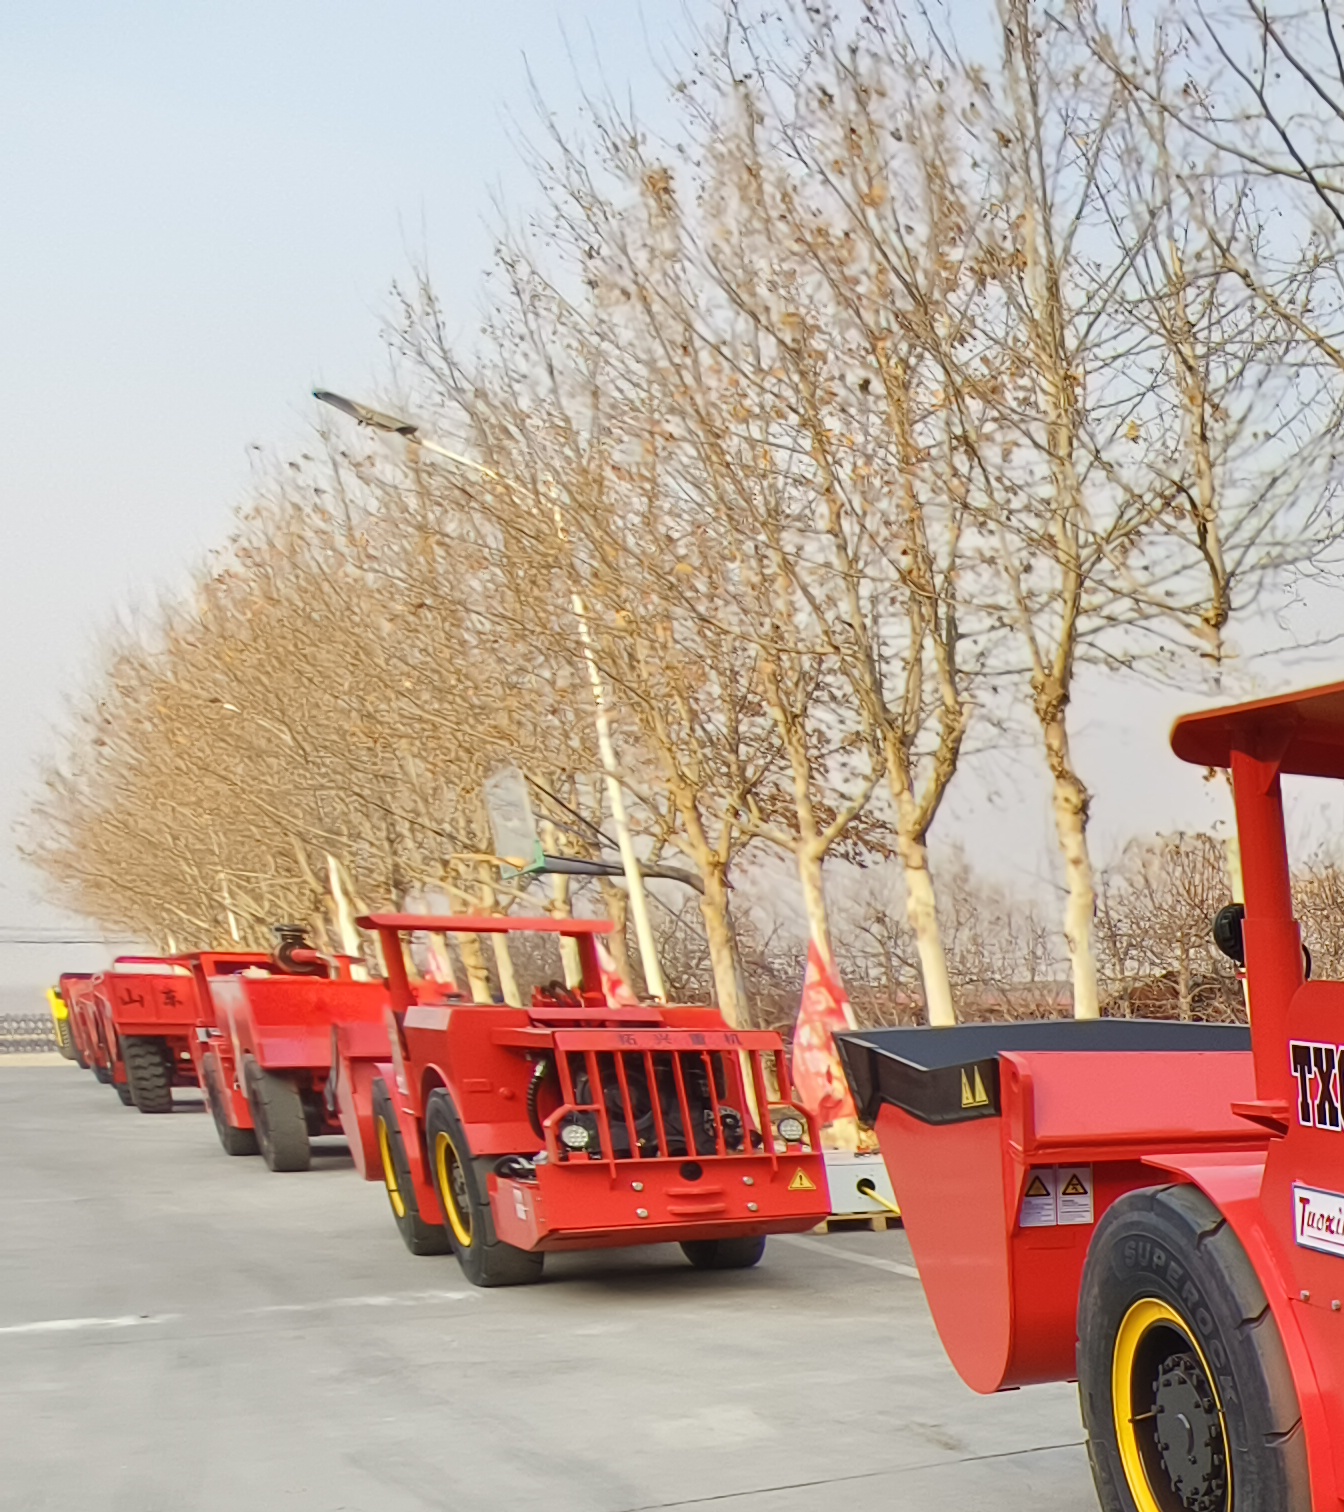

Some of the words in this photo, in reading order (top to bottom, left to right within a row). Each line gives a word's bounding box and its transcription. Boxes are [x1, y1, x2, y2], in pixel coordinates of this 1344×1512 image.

[618, 1032, 743, 1046] 拓兴机
[1123, 1240, 1238, 1404] SUPEROCK
